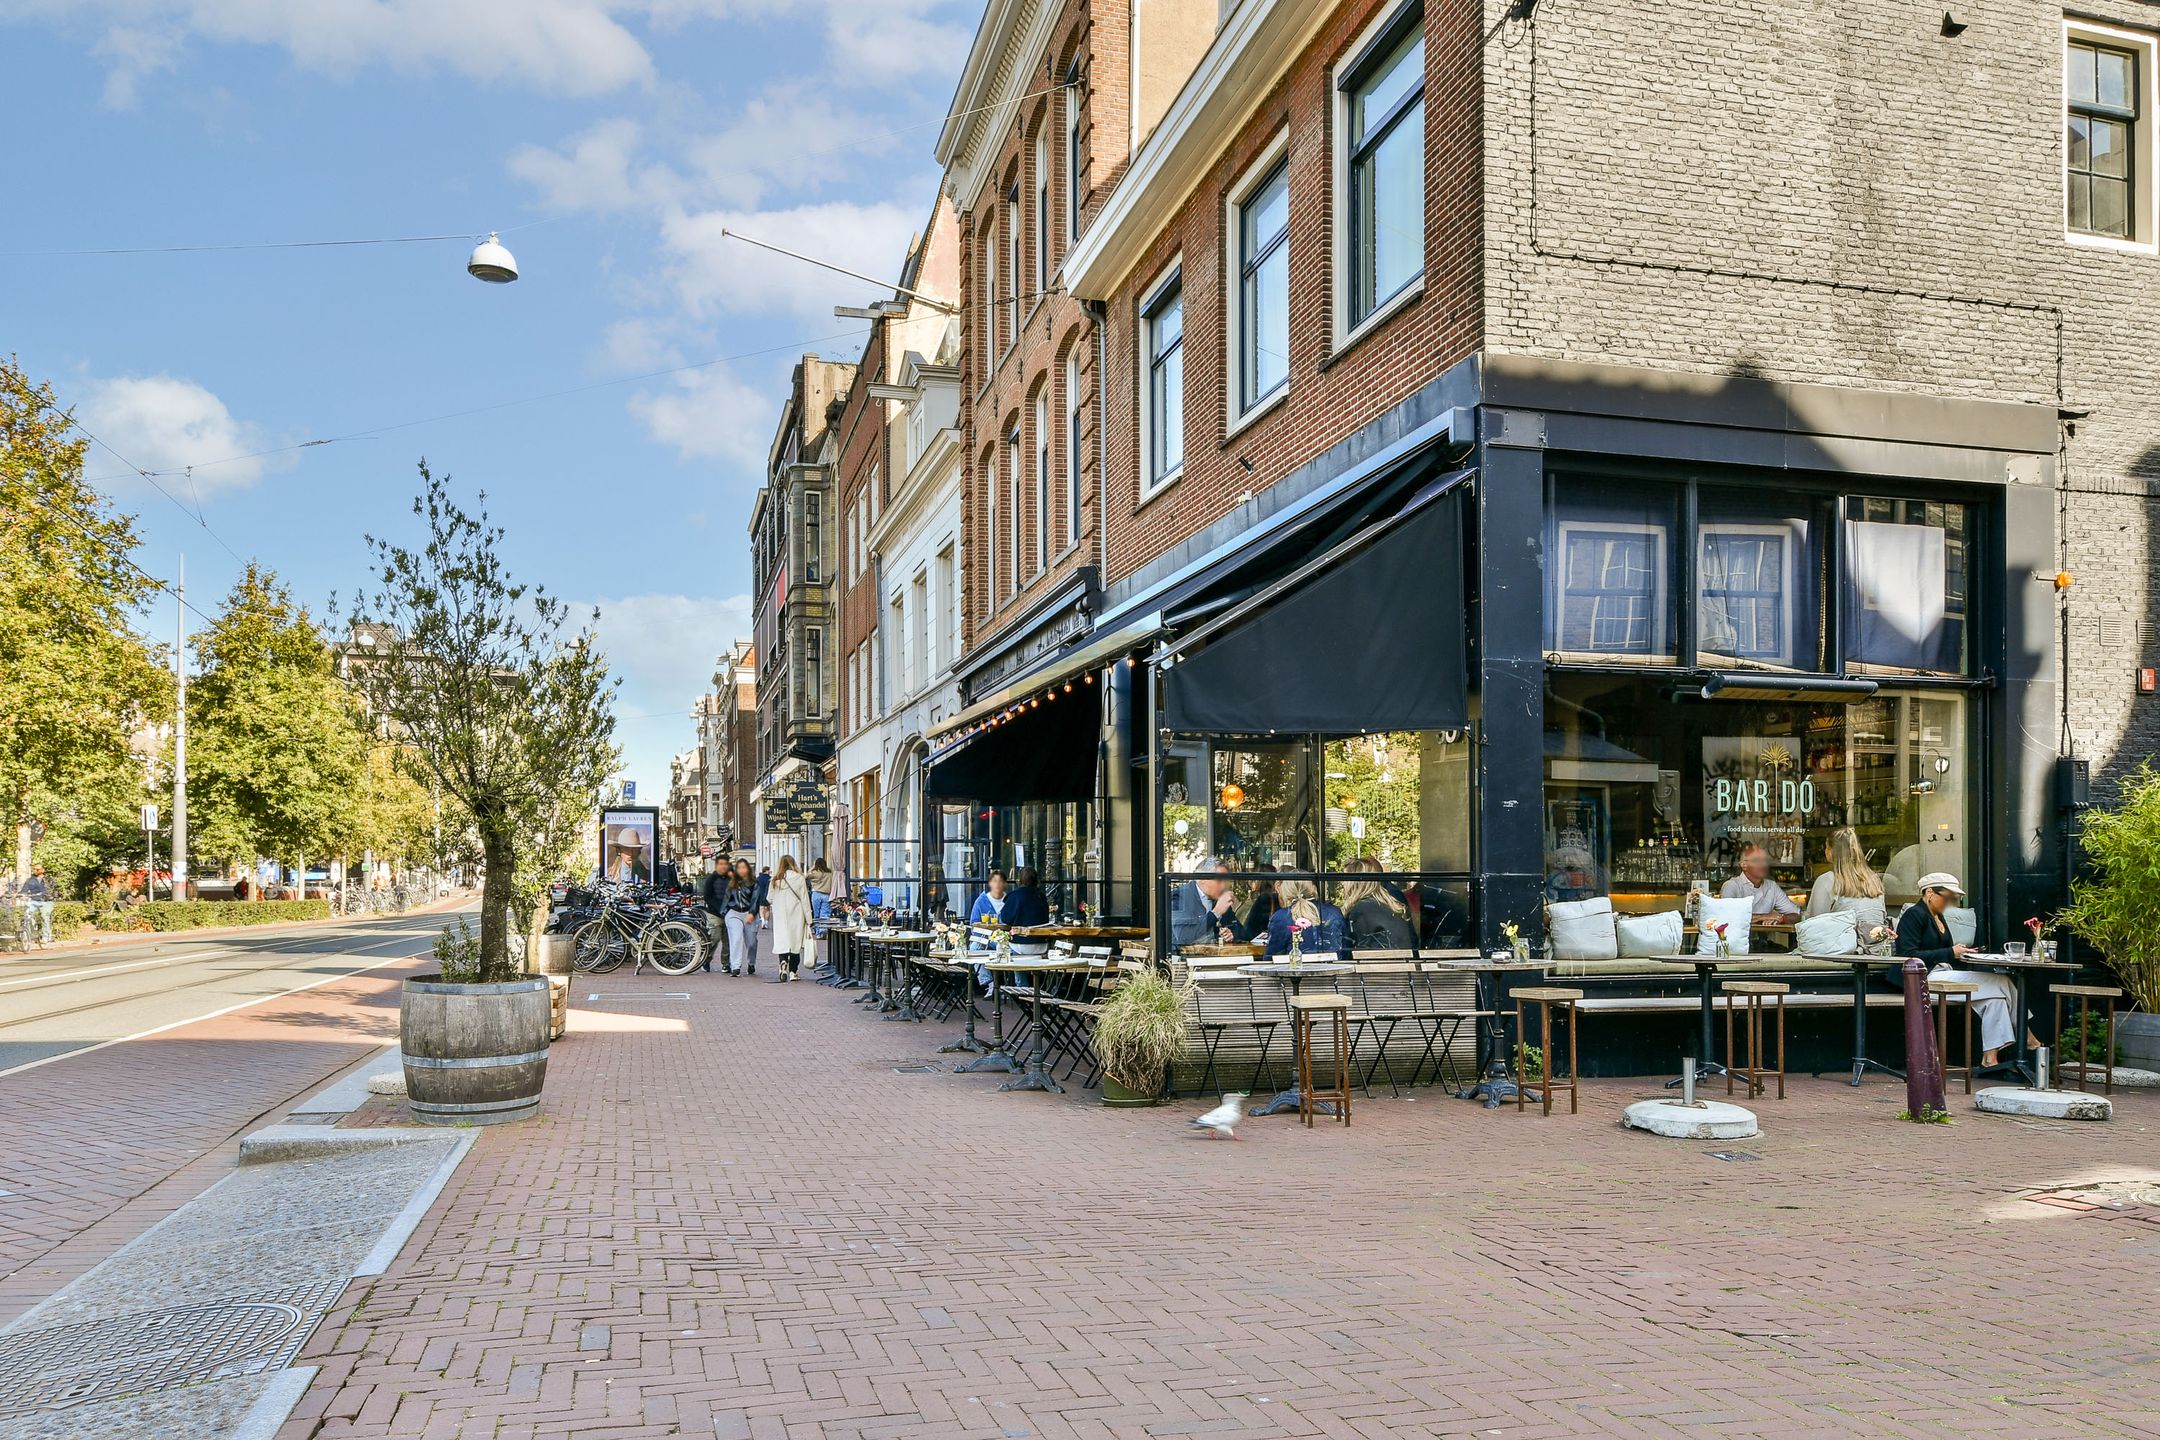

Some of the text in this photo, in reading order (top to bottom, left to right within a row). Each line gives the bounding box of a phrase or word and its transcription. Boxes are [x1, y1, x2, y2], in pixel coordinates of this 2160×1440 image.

[626, 782, 633, 792] P
[1717, 775, 1815, 812] BAR DÓ
[790, 801, 826, 810] Wijnhandel
[1795, 826, 1806, 834] day
